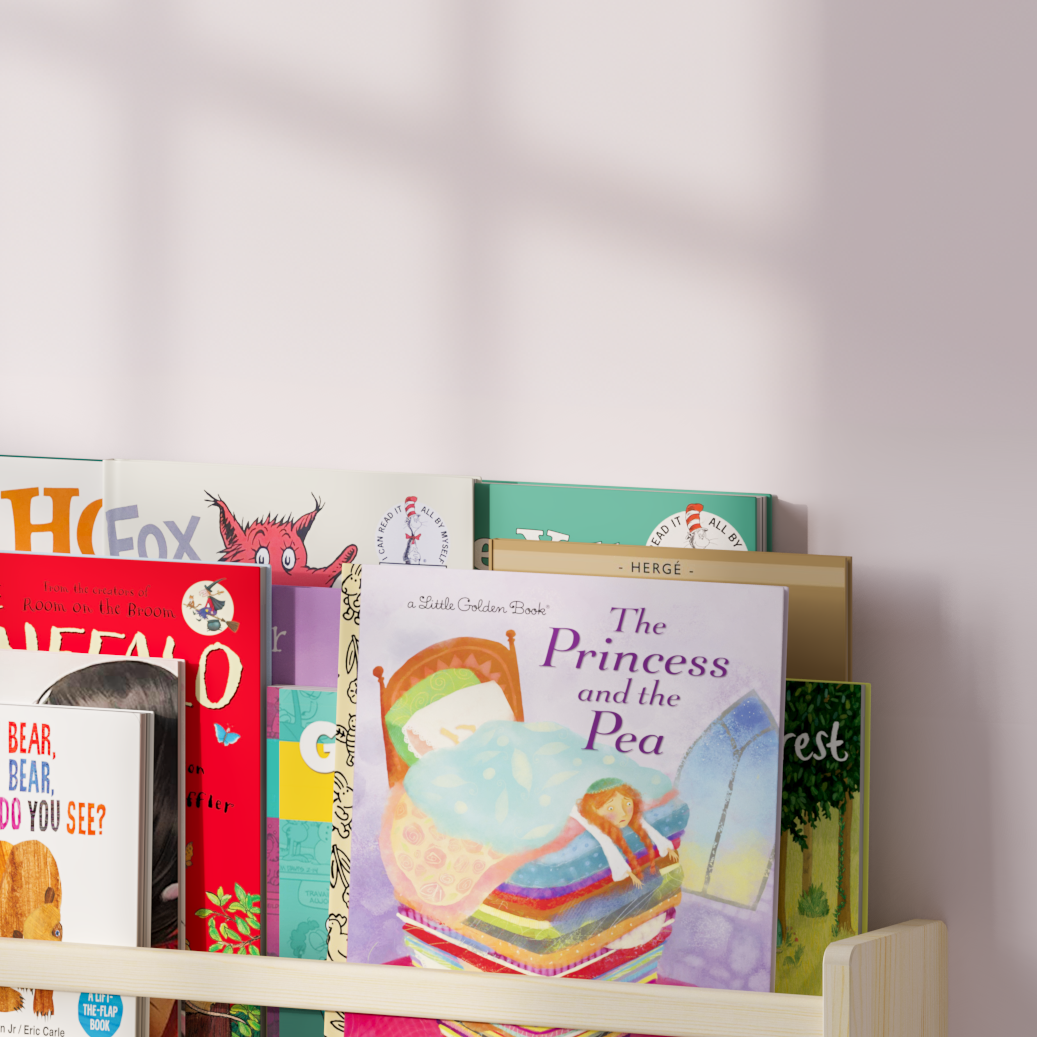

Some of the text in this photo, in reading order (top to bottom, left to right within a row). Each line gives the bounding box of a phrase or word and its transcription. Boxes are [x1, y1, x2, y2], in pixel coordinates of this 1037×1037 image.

[394, 505, 402, 514] IT
[421, 506, 434, 519] ALL
[378, 512, 393, 533] READ
[435, 517, 445, 528] BY
[649, 516, 743, 548] EAD IT ALL BY
[377, 536, 385, 554] CAN
[439, 531, 449, 564] MYSELF
[631, 561, 682, 575] HERGÉ
[44, 581, 151, 597] From the creators of
[23, 597, 176, 618] Room on the Broom
[407, 601, 416, 609] a
[419, 595, 455, 610] Little
[457, 597, 507, 613] Golden
[610, 606, 667, 636] The
[539, 626, 730, 678] Princess
[577, 677, 681, 707] and the
[8, 721, 56, 760] BEAR,
[581, 710, 665, 755] Pea
[8, 758, 55, 797] BEAR,
[0, 797, 22, 830] DO
[28, 799, 61, 832] YOU
[66, 800, 107, 836] SEE?
[82, 1003, 119, 1018] THE-FLAP
[8, 1024, 16, 1034] Jr
[24, 1025, 41, 1036] Eric
[42, 1026, 65, 1037] Carle
[89, 1018, 111, 1032] BOOK
